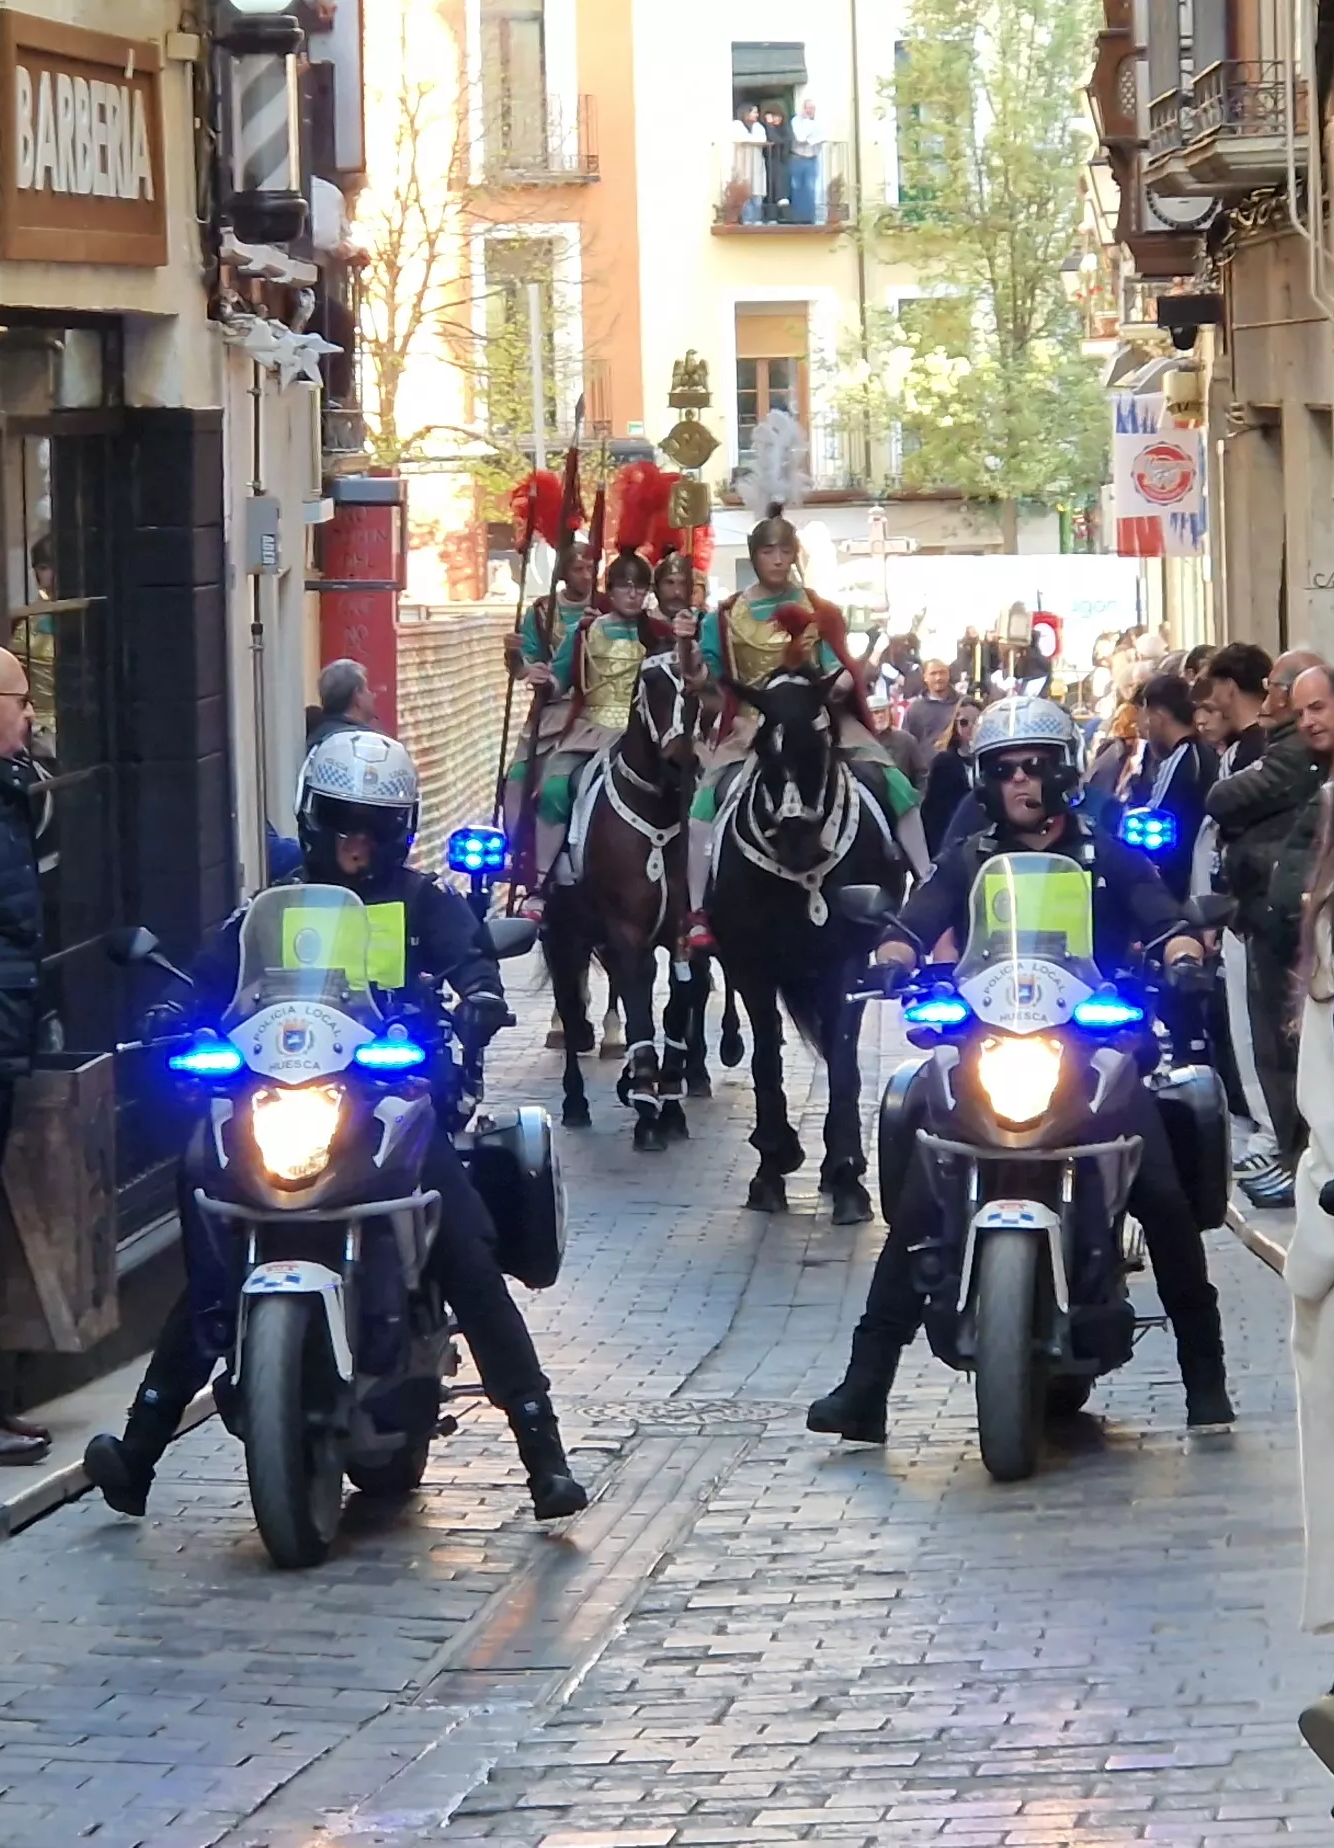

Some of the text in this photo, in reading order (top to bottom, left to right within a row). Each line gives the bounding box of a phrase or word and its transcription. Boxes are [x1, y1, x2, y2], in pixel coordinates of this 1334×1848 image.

[16, 48, 154, 201] BARBERÍA
[1032, 963, 1066, 993] LOCAL
[253, 1005, 341, 1041] POLICIA LOCAL
[269, 1060, 321, 1073] HUESCA
